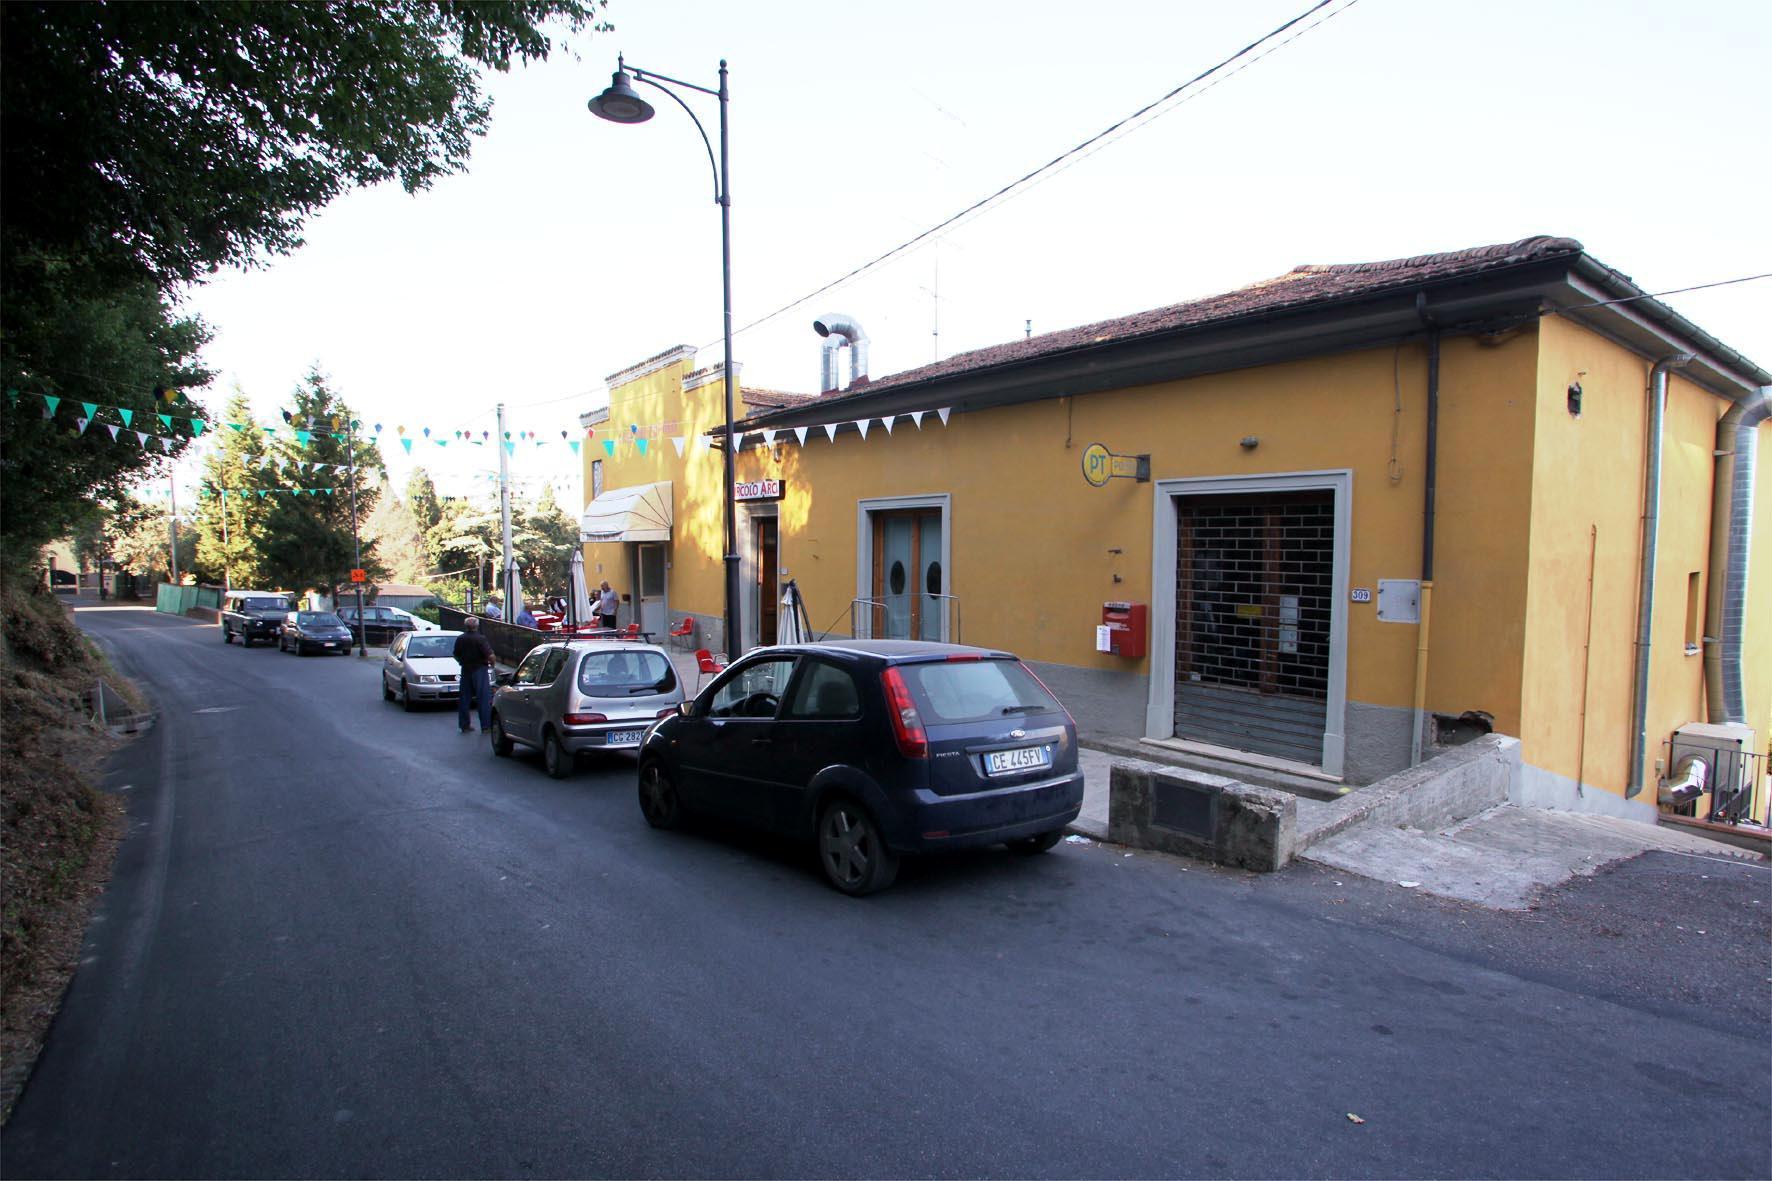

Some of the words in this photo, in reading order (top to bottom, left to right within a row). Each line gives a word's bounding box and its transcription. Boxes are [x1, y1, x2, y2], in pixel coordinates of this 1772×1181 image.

[1090, 454, 1106, 475] PT
[760, 481, 778, 495] ARCI
[1352, 590, 1369, 600] 309
[992, 753, 1008, 770] CE
[1011, 748, 1041, 769] 445FV
